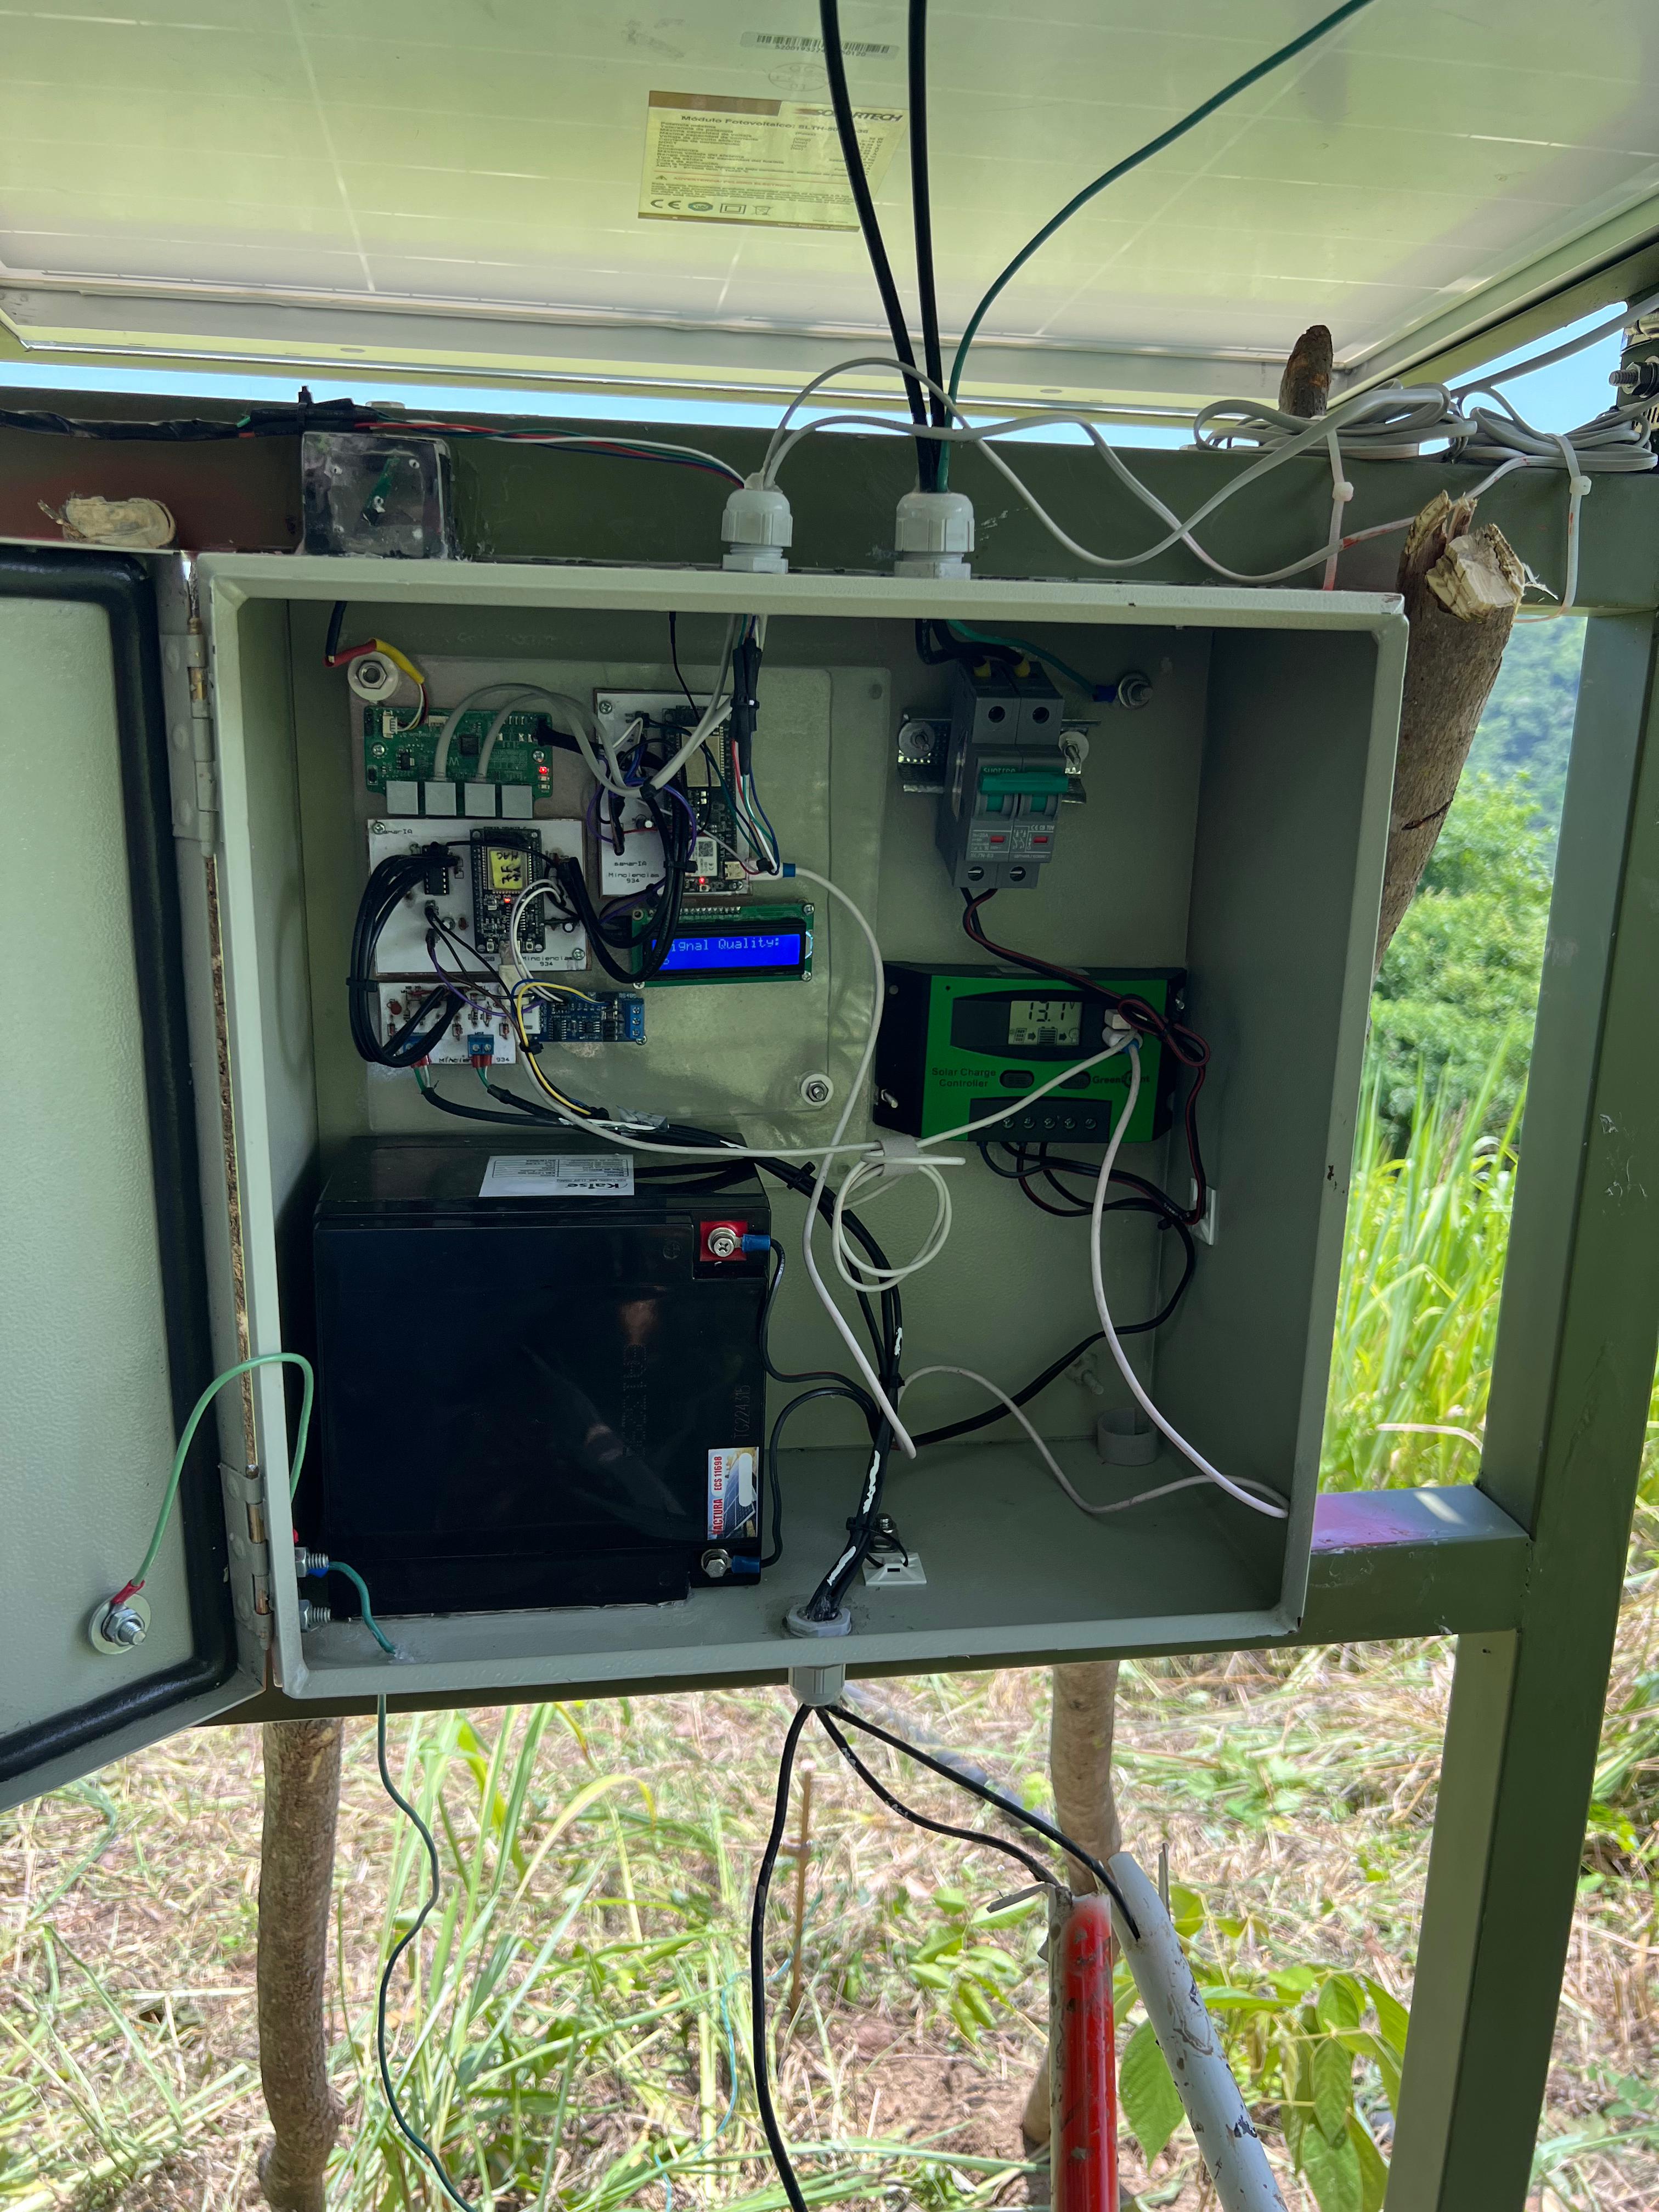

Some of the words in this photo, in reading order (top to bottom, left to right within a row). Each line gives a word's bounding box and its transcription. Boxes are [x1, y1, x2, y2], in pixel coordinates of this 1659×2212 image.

[815, 109, 903, 122] SORTECH
[670, 940, 708, 952] ignal
[718, 937, 779, 950] Quality:
[1028, 1001, 1065, 1023] 13.1
[932, 1067, 957, 1076] Solar
[960, 1068, 996, 1078] Charge
[939, 1079, 988, 1087] Controller
[714, 1456, 723, 1477] 11698
[714, 1479, 723, 1491] ECS
